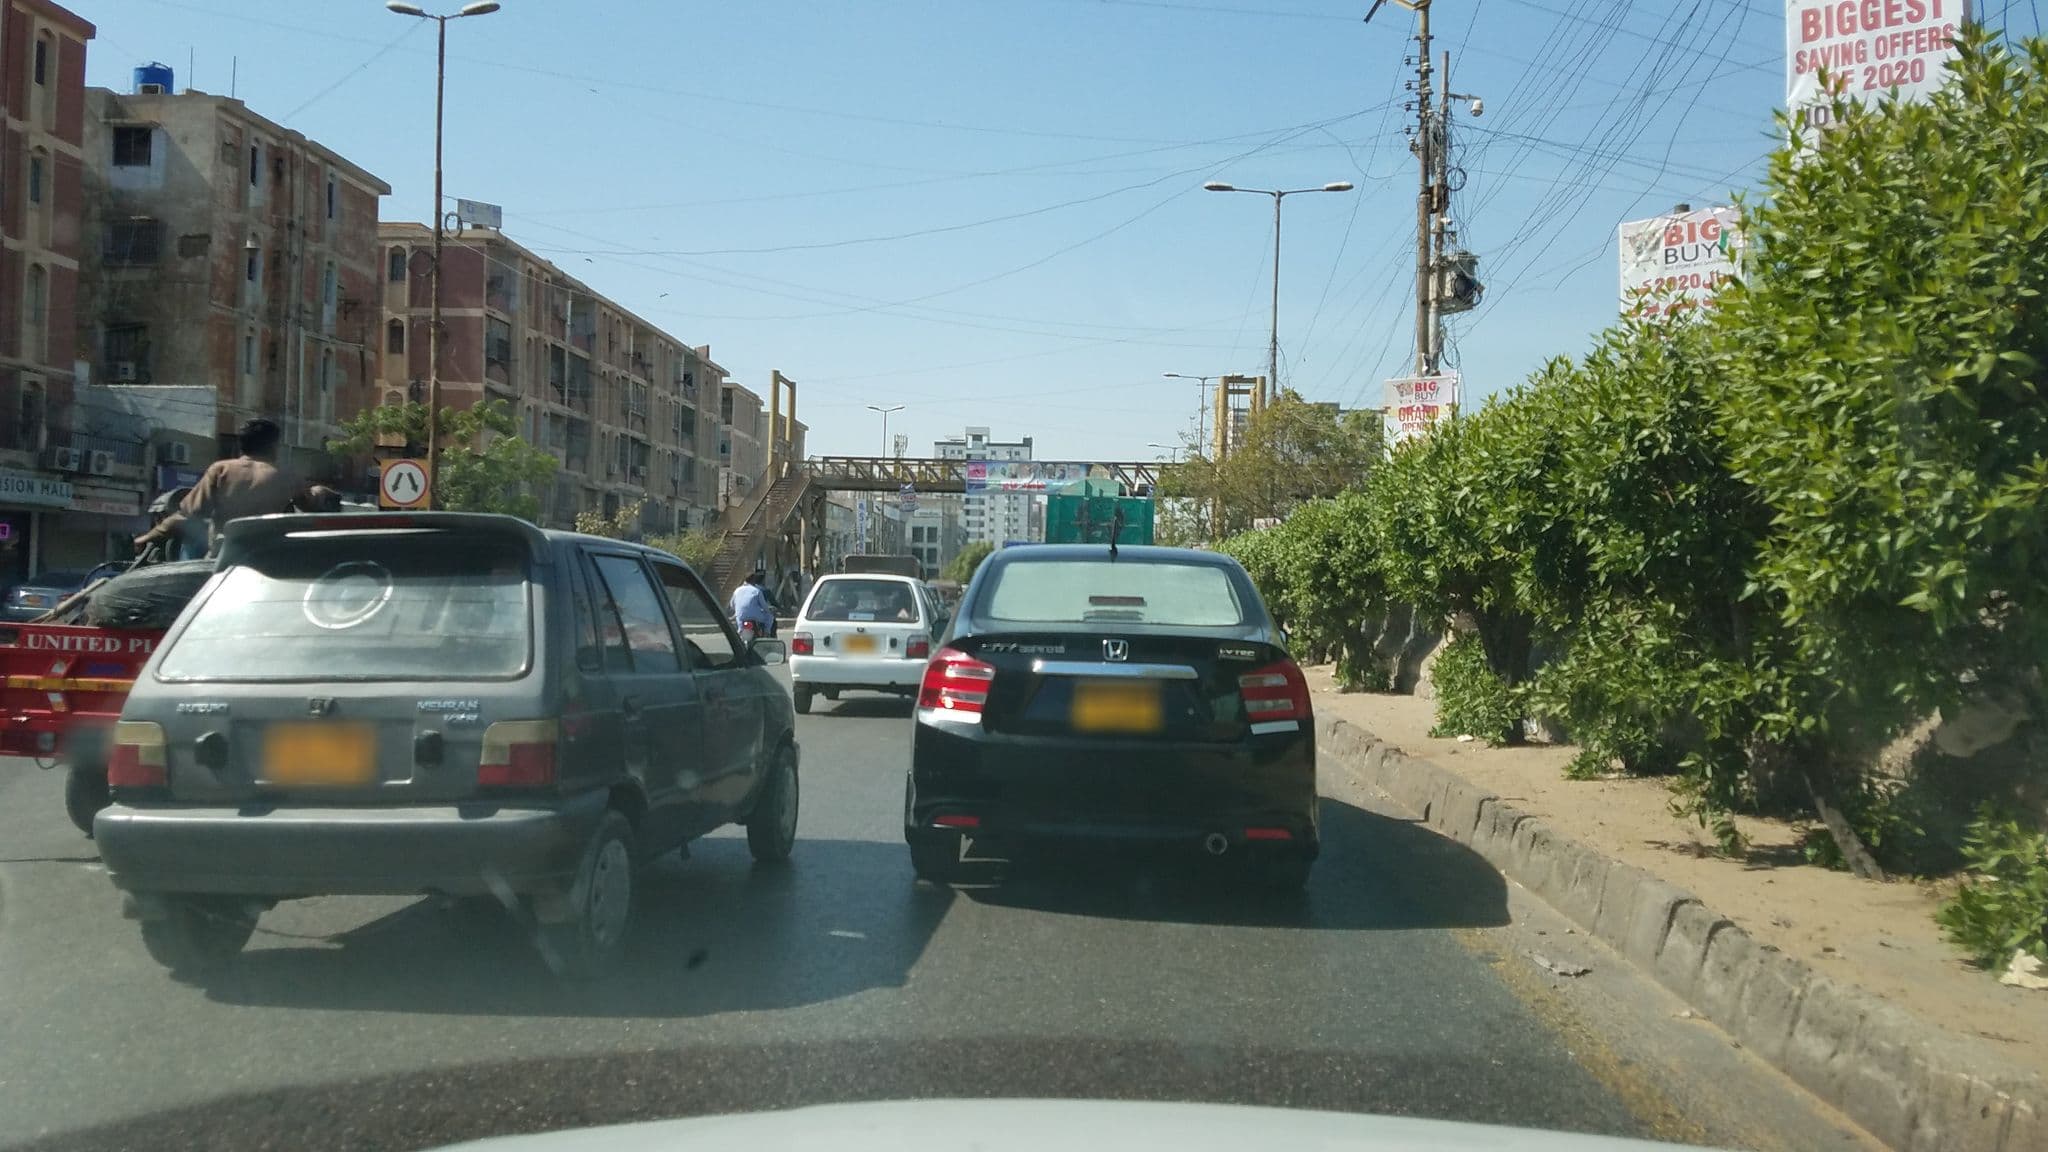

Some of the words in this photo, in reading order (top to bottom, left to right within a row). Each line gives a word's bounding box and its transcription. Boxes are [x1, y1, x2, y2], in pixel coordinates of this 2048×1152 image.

[1795, 38, 1868, 75] SAVING
[1874, 23, 1955, 61] OFFERS
[1863, 58, 1925, 91] 2020
[1664, 218, 1721, 247] BIG
[1664, 241, 1718, 265] BUY
[1415, 381, 1437, 392] BIG
[41, 481, 71, 498] MALL
[27, 634, 122, 653] UNITED
